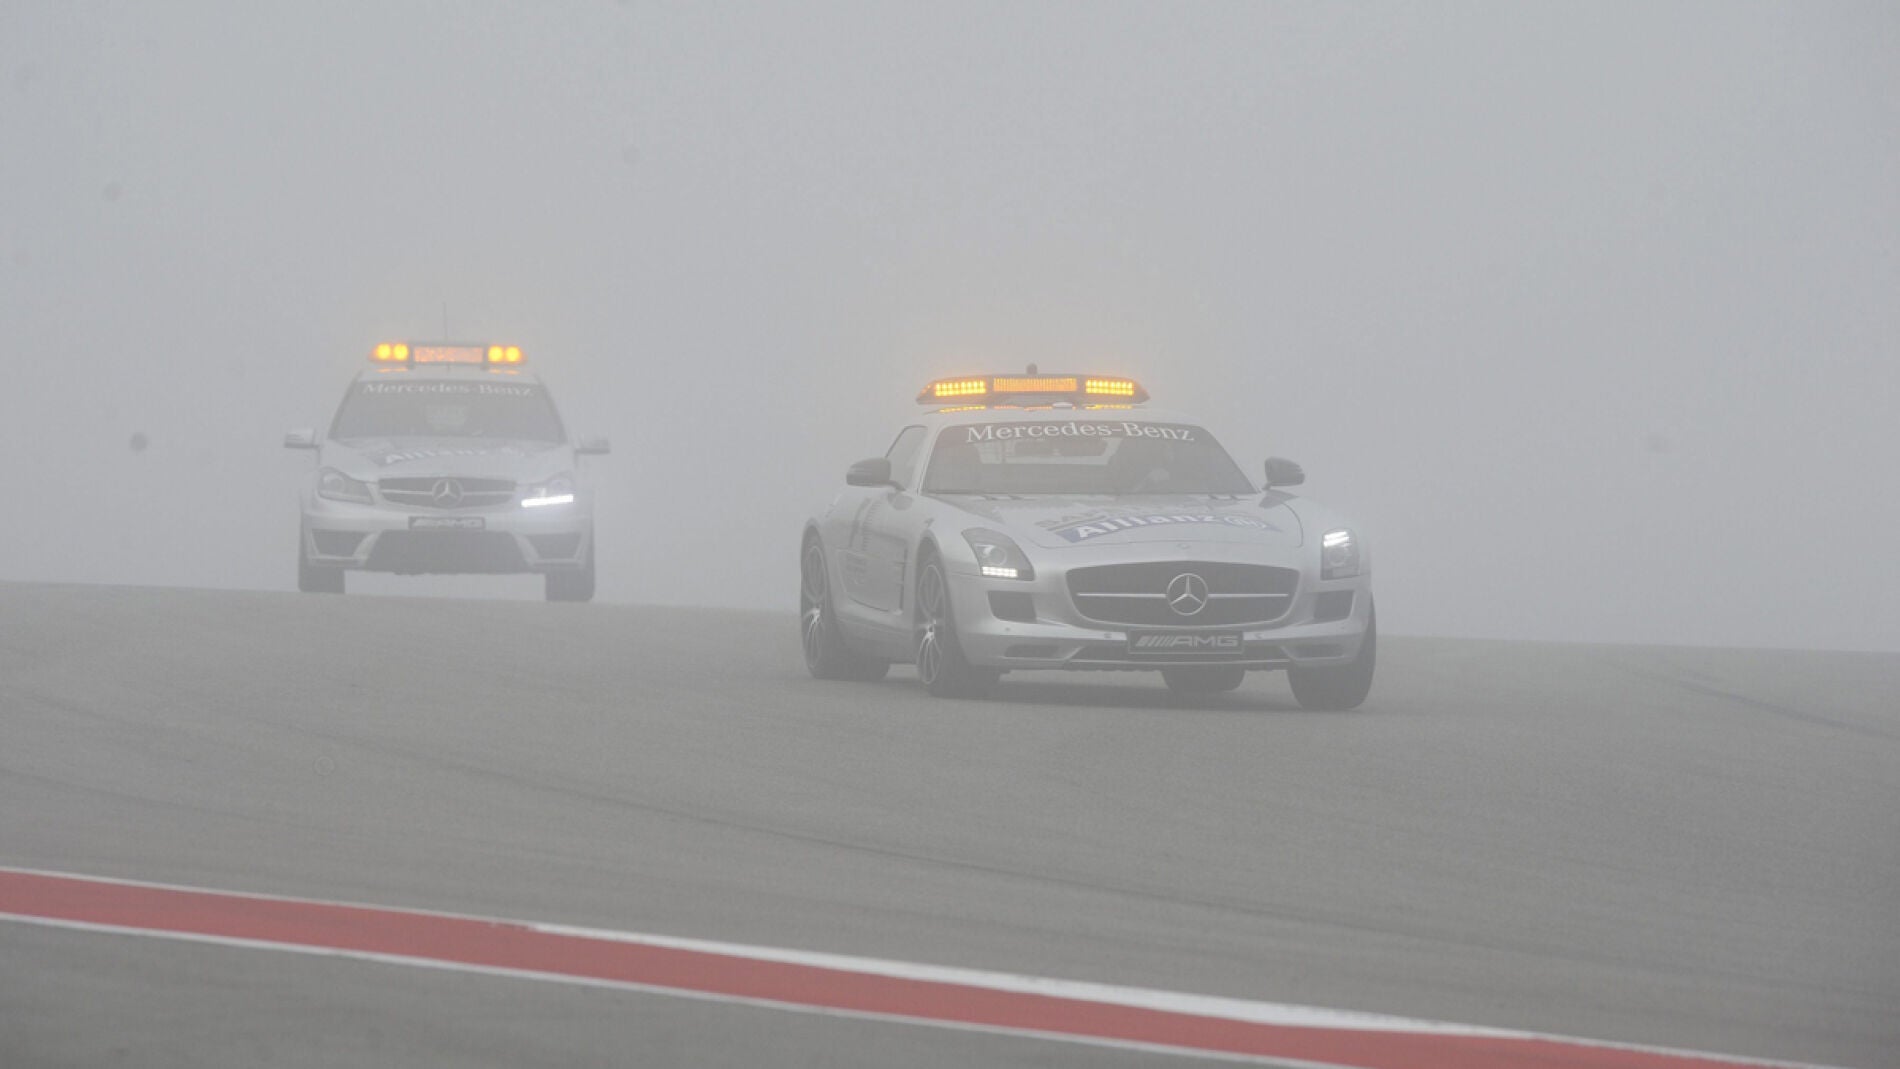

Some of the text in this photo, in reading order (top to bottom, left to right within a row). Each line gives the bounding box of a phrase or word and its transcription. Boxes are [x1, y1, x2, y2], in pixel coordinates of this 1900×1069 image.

[364, 383, 533, 396] Mercedes-Benz
[966, 421, 1195, 443] Mercedes-Benz
[1077, 514, 1217, 539] Allianz
[1169, 634, 1239, 648] AMG
